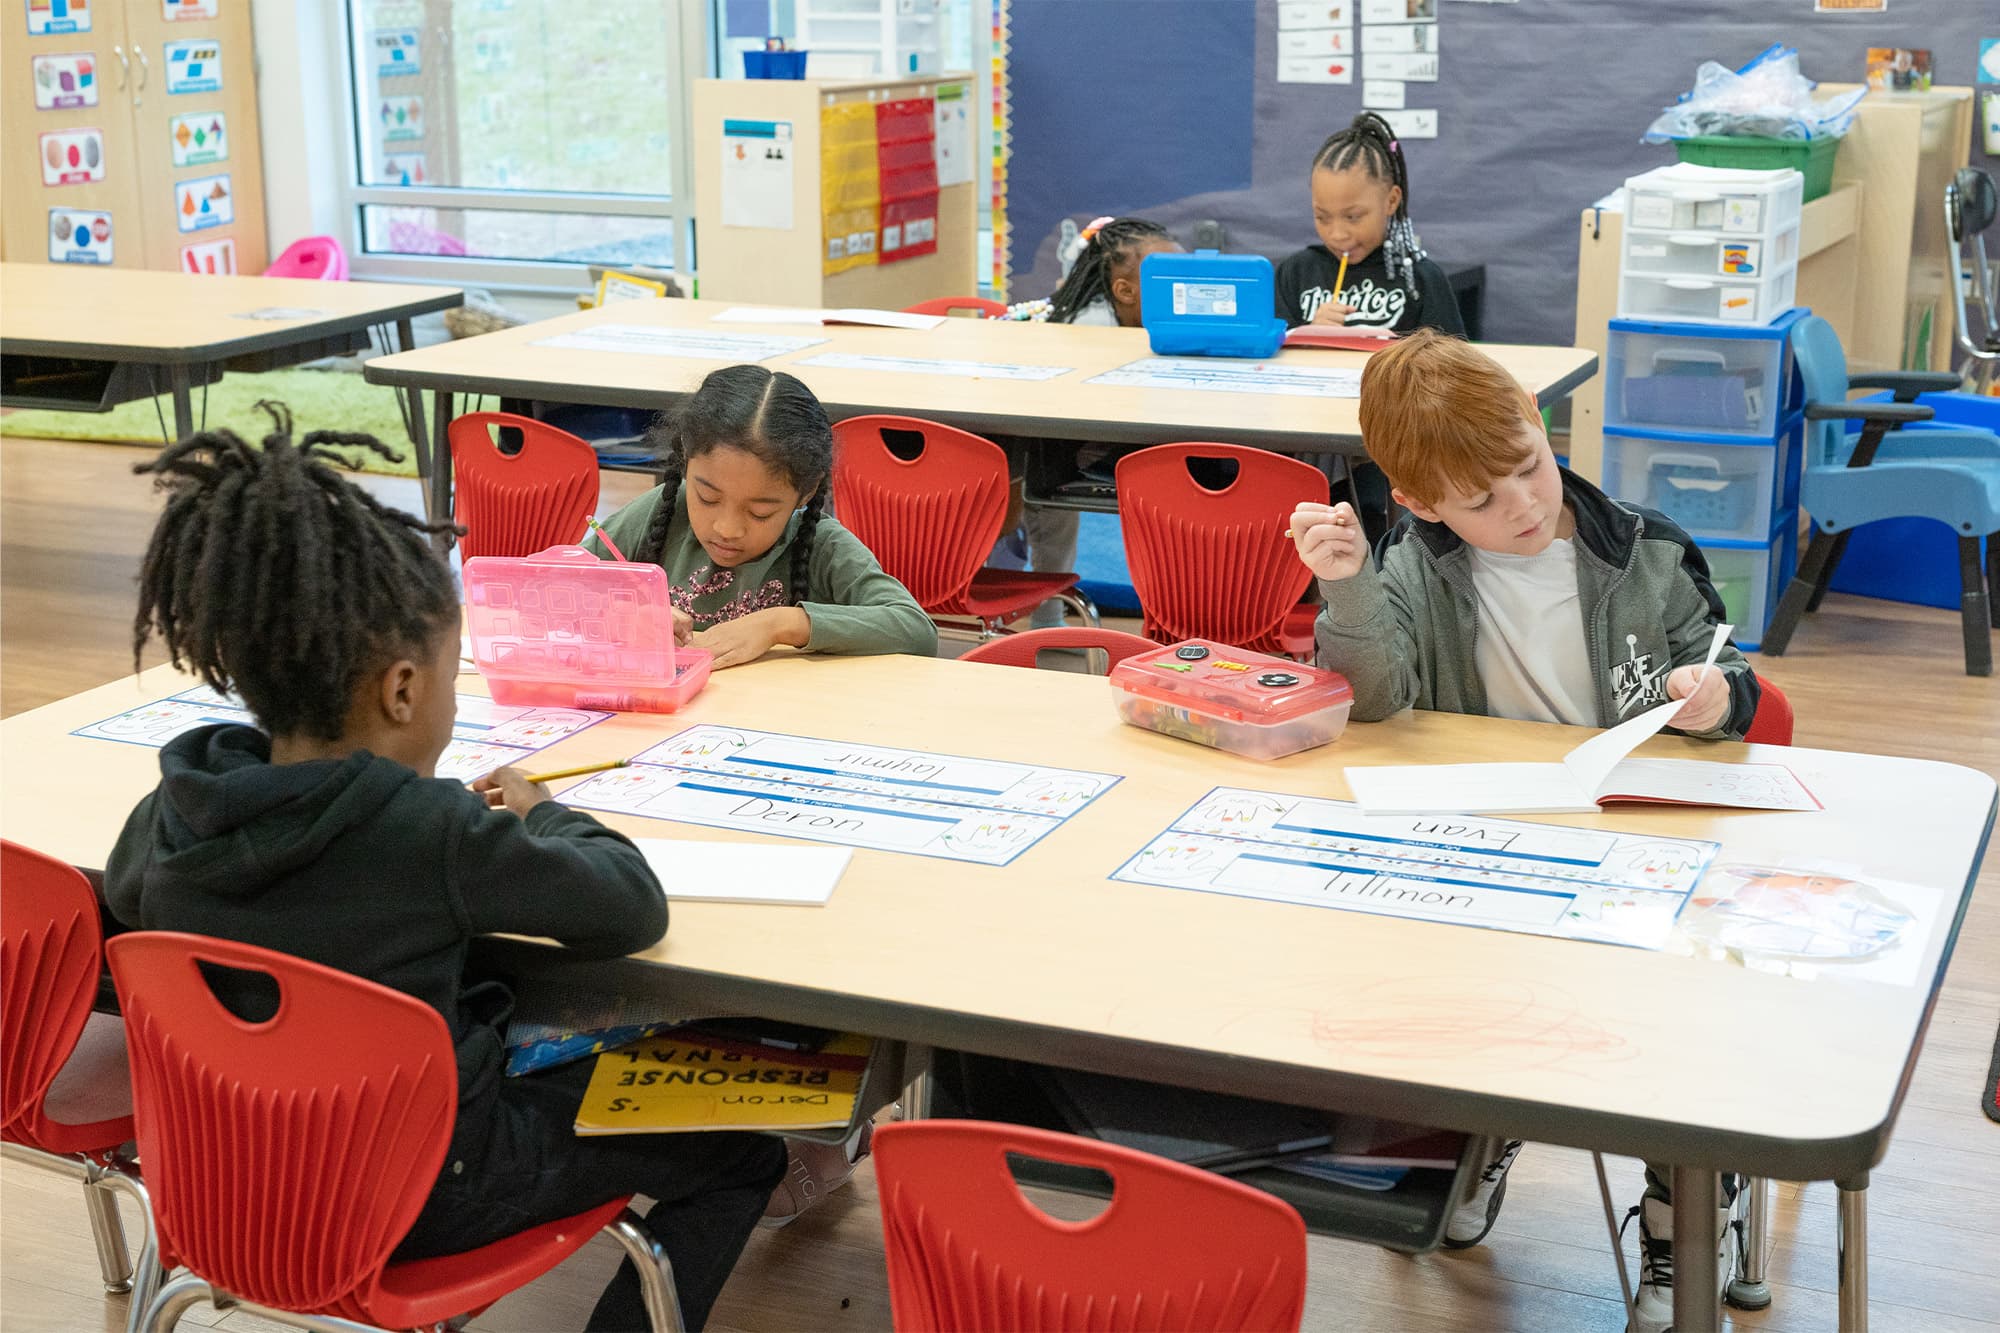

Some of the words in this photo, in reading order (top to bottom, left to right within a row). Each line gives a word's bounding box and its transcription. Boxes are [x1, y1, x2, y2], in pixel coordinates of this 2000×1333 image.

[728, 796, 864, 831] Deron
[1412, 822, 1521, 851] Evan
[616, 1068, 830, 1087] RESPONSE
[721, 1094, 829, 1106] Deron
